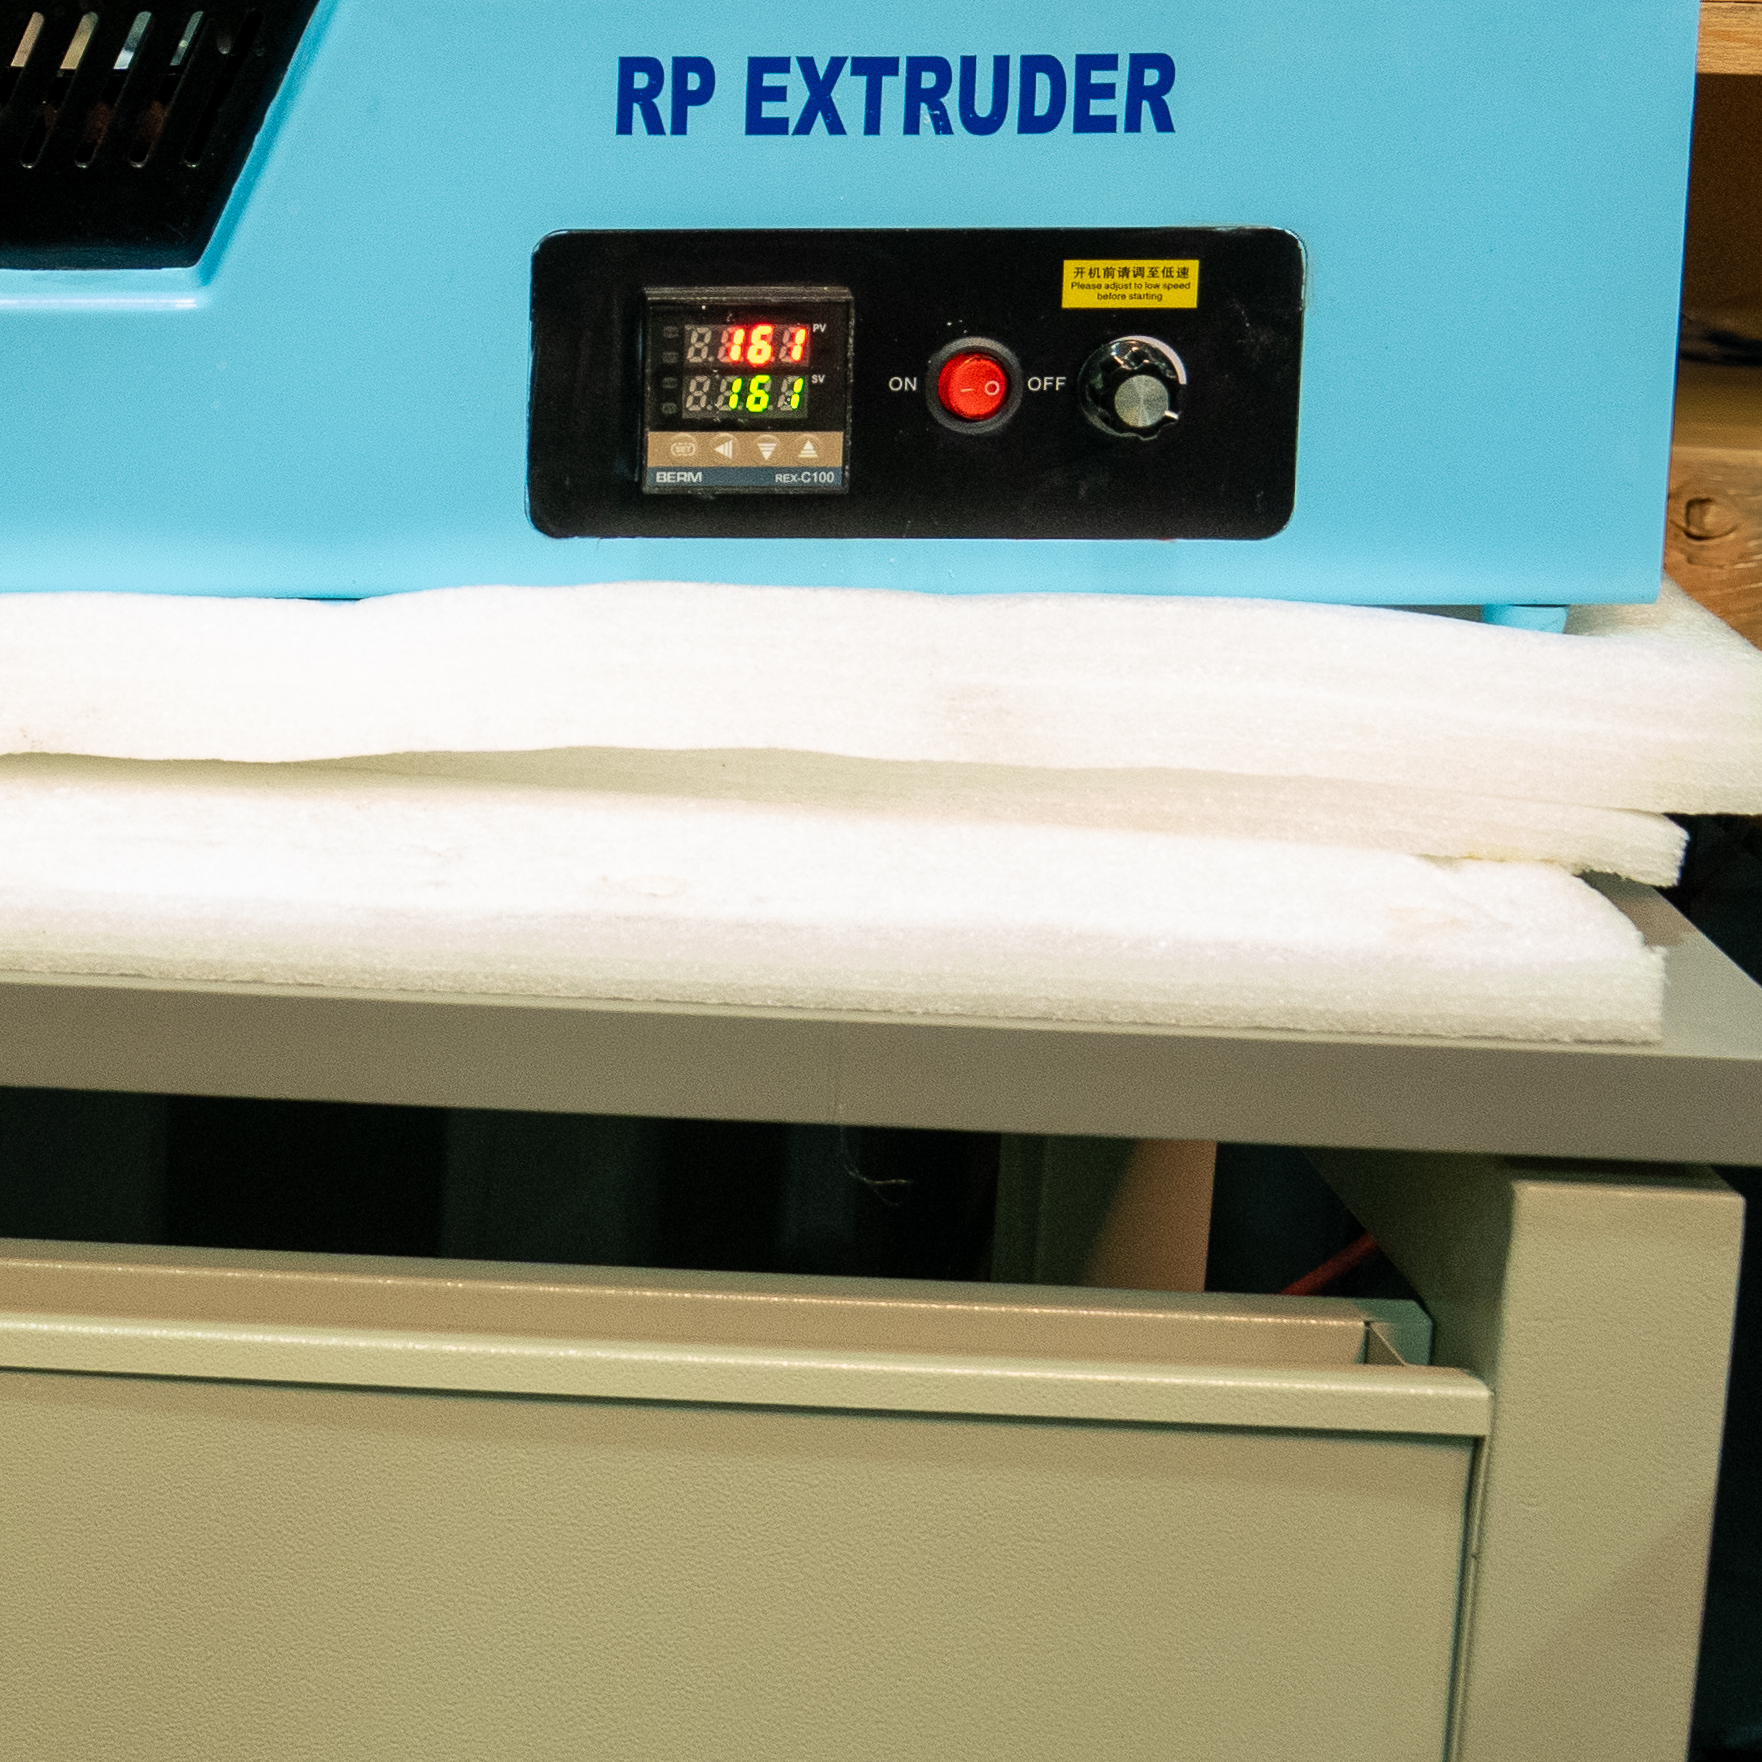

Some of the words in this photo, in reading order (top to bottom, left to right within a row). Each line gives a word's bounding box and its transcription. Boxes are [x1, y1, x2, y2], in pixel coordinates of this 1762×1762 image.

[615, 55, 716, 137] RP
[744, 52, 1177, 137] EXTRUDER
[1073, 266, 1190, 279] 开机前请调至低速
[1104, 282, 1132, 291] adjust
[1162, 282, 1191, 291] speed
[1097, 292, 1126, 300] before
[1128, 292, 1163, 302] starting
[812, 323, 826, 333] PV
[729, 324, 806, 365] 161
[811, 374, 826, 384] SV
[888, 376, 918, 391] ON
[1027, 376, 1067, 391] OFF
[728, 374, 804, 413] 161
[655, 471, 703, 483] BERM
[775, 470, 835, 483] REX-C100
